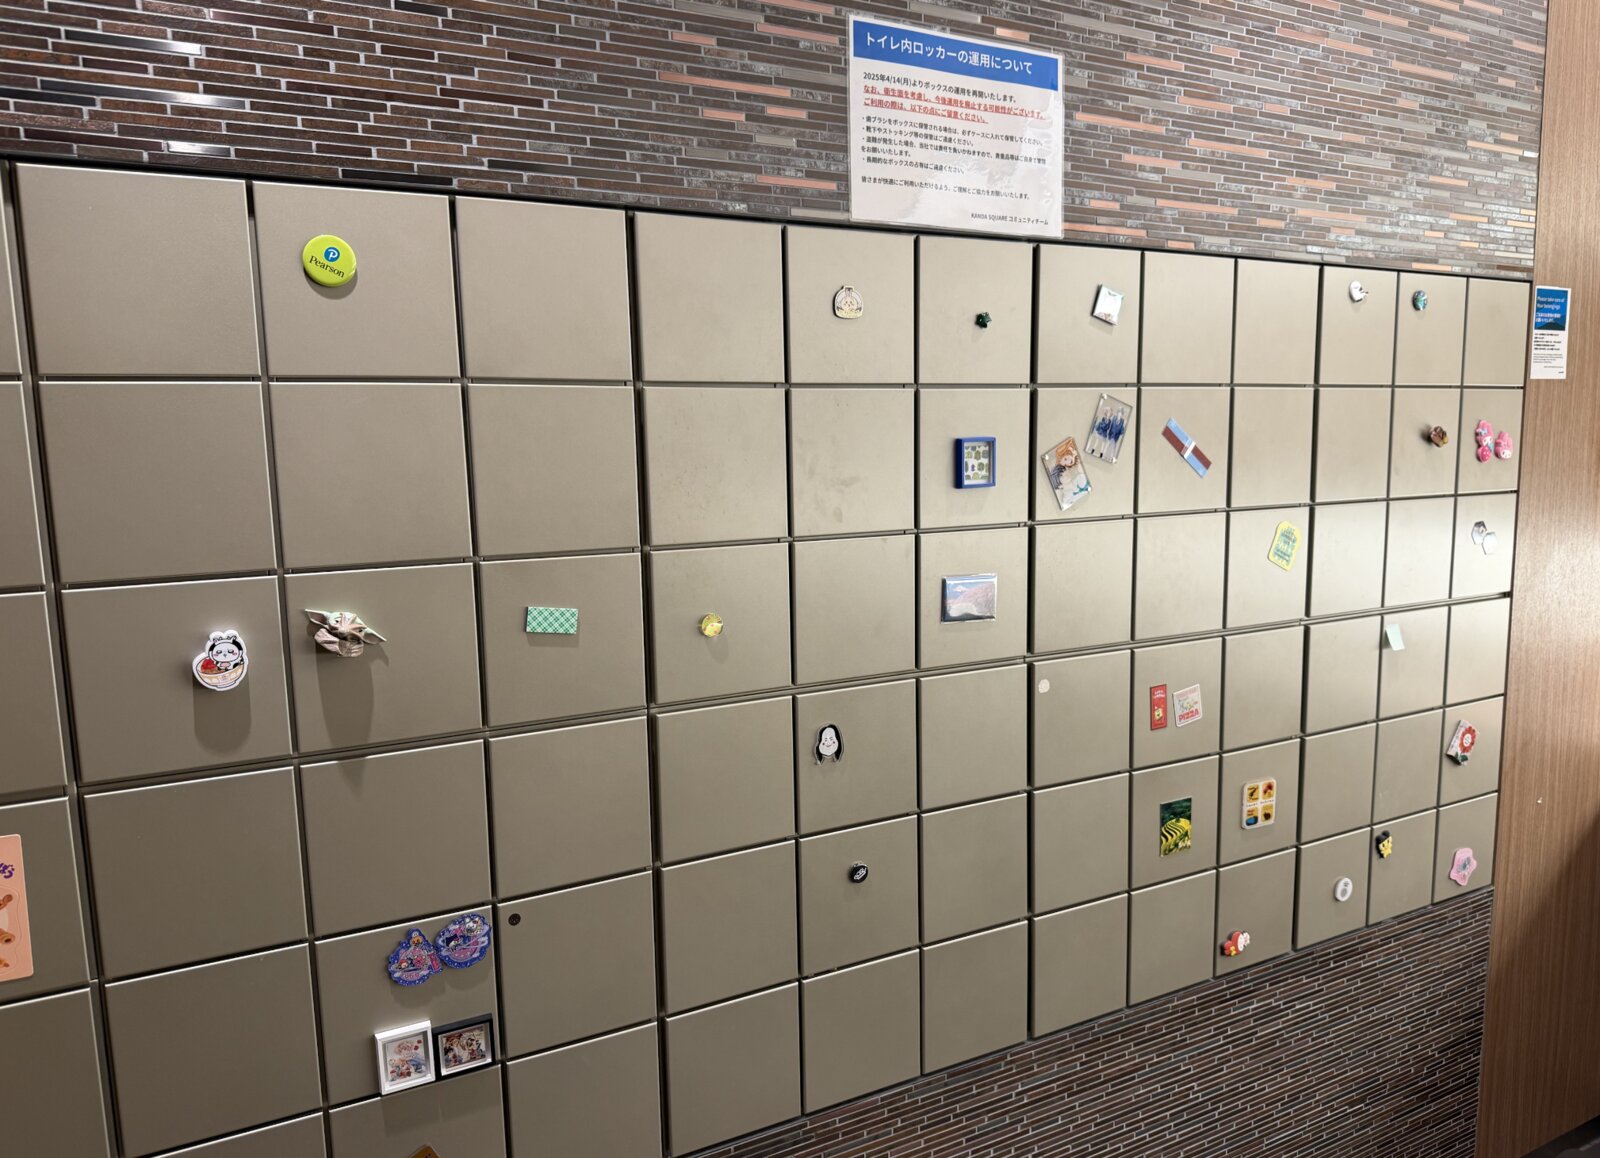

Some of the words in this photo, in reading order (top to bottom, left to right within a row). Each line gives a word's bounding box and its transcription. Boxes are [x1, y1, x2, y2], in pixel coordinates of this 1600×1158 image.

[866, 31, 1033, 75] トイレ内ロッカーの運用について
[863, 71, 1017, 103] 2025年4/14(月)よりボックスの運用を再開いたします。
[970, 212, 988, 220] KANDA
[988, 214, 1008, 222] SQUARE
[309, 255, 345, 278] Pearson
[1178, 708, 1200, 722] PIZZA
